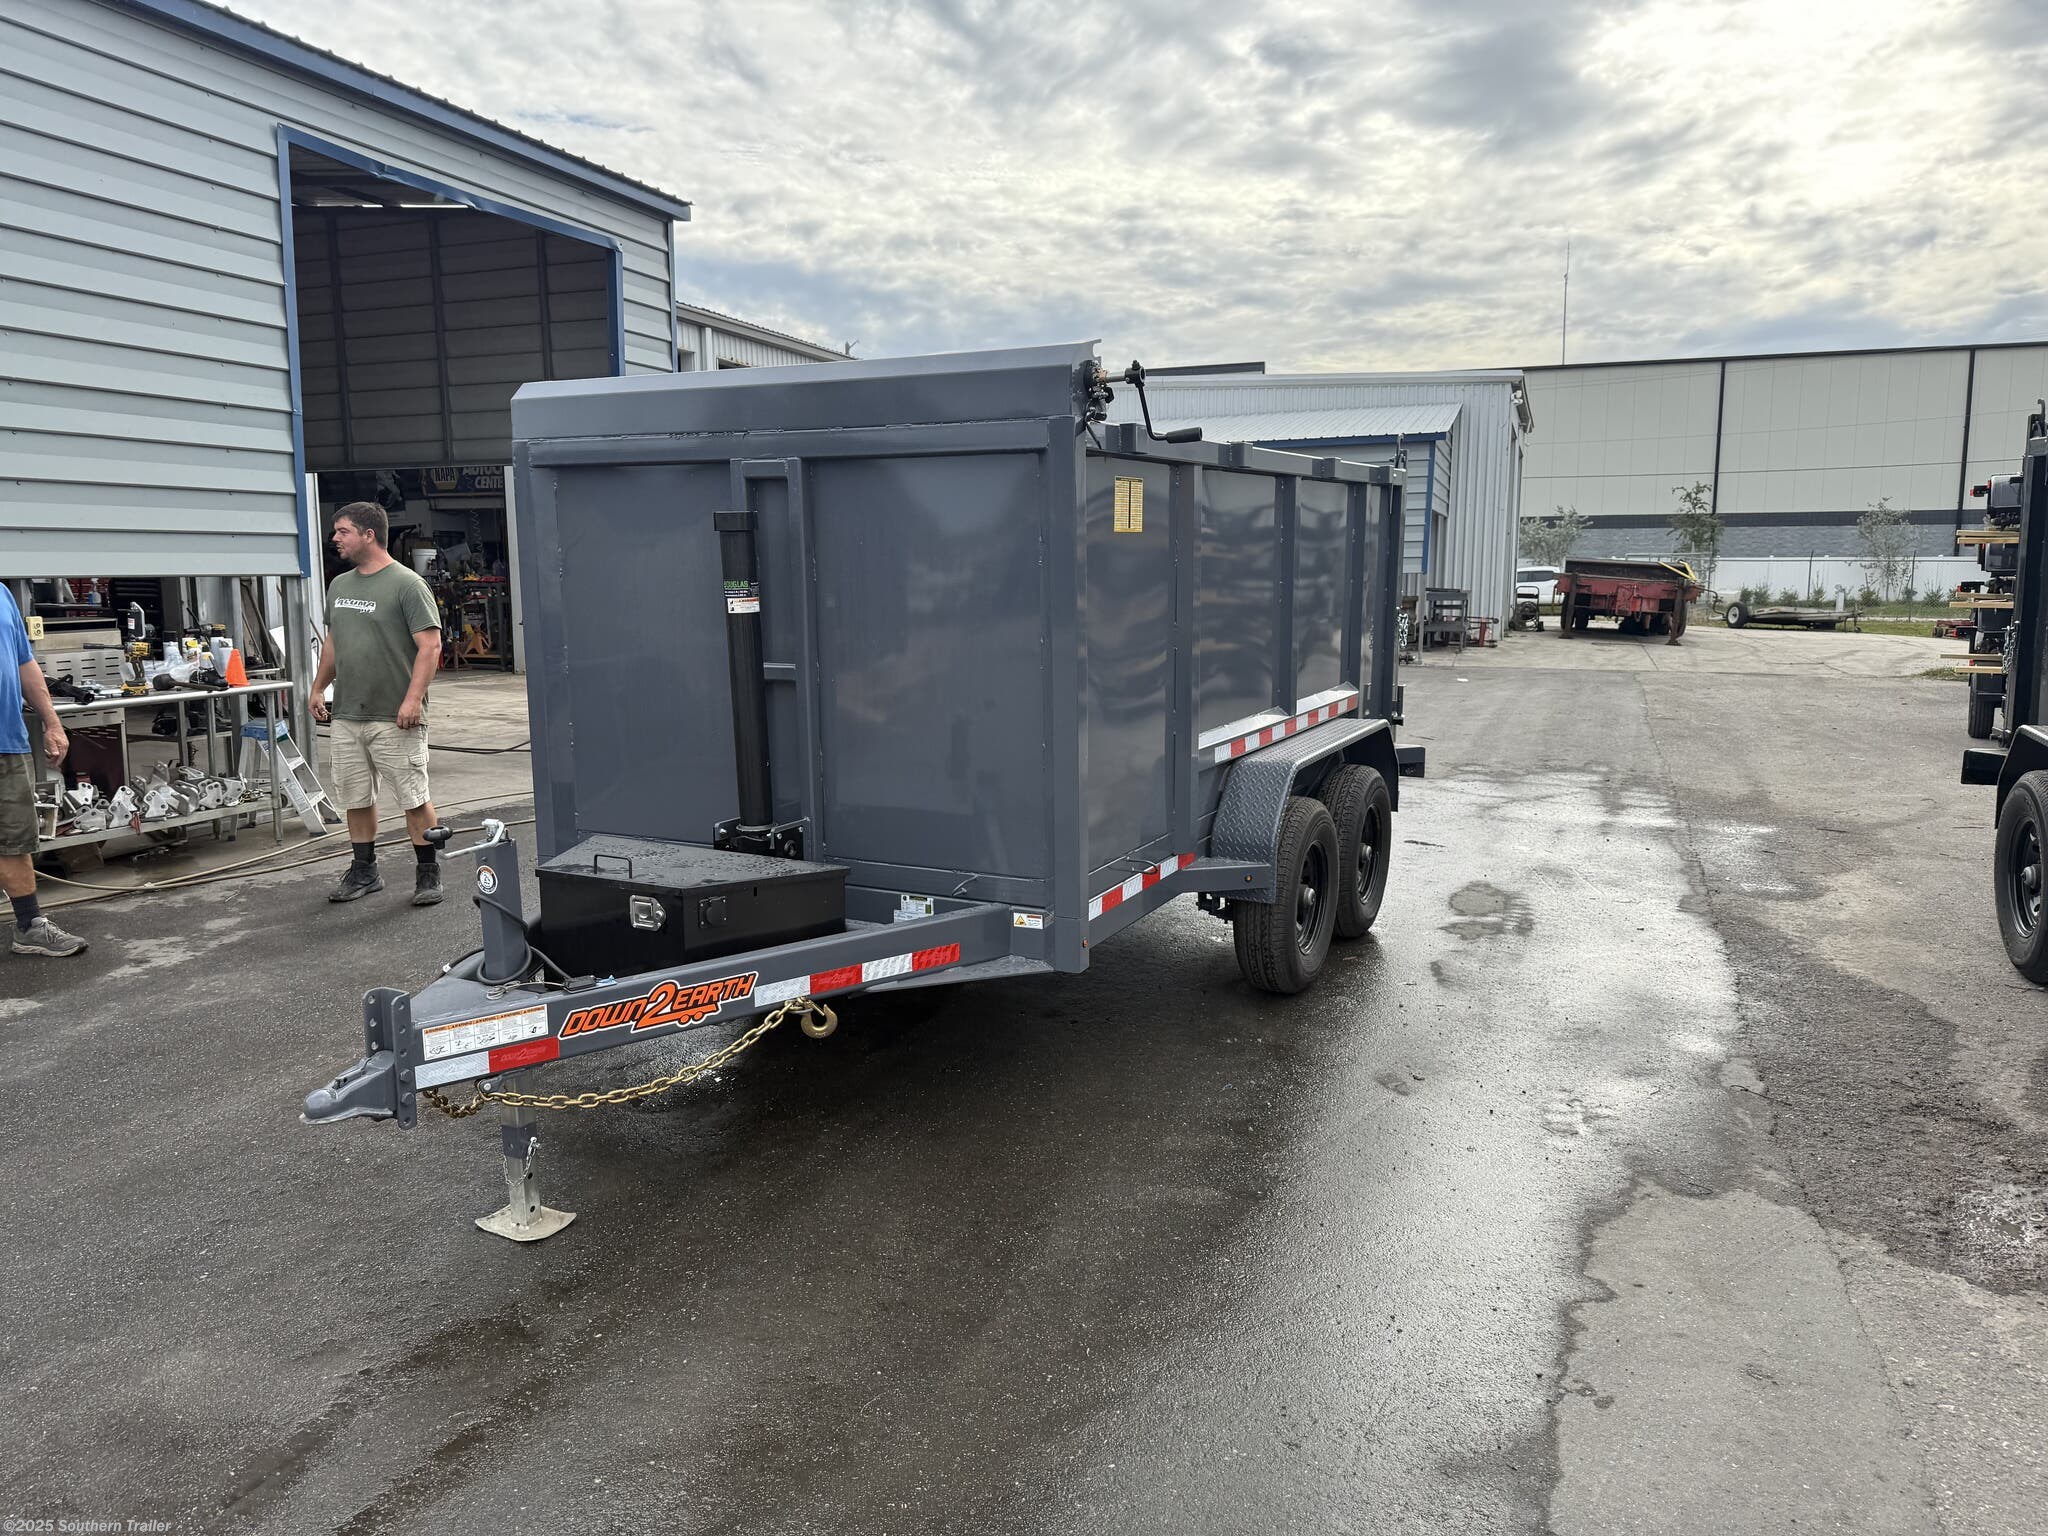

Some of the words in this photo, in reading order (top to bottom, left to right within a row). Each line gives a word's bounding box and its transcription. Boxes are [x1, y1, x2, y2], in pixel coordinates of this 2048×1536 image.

[433, 466, 456, 481] NAPA
[463, 466, 503, 475] AUTOC
[475, 476, 503, 488] CENTE
[559, 972, 758, 1038] DOWN2EARTH
